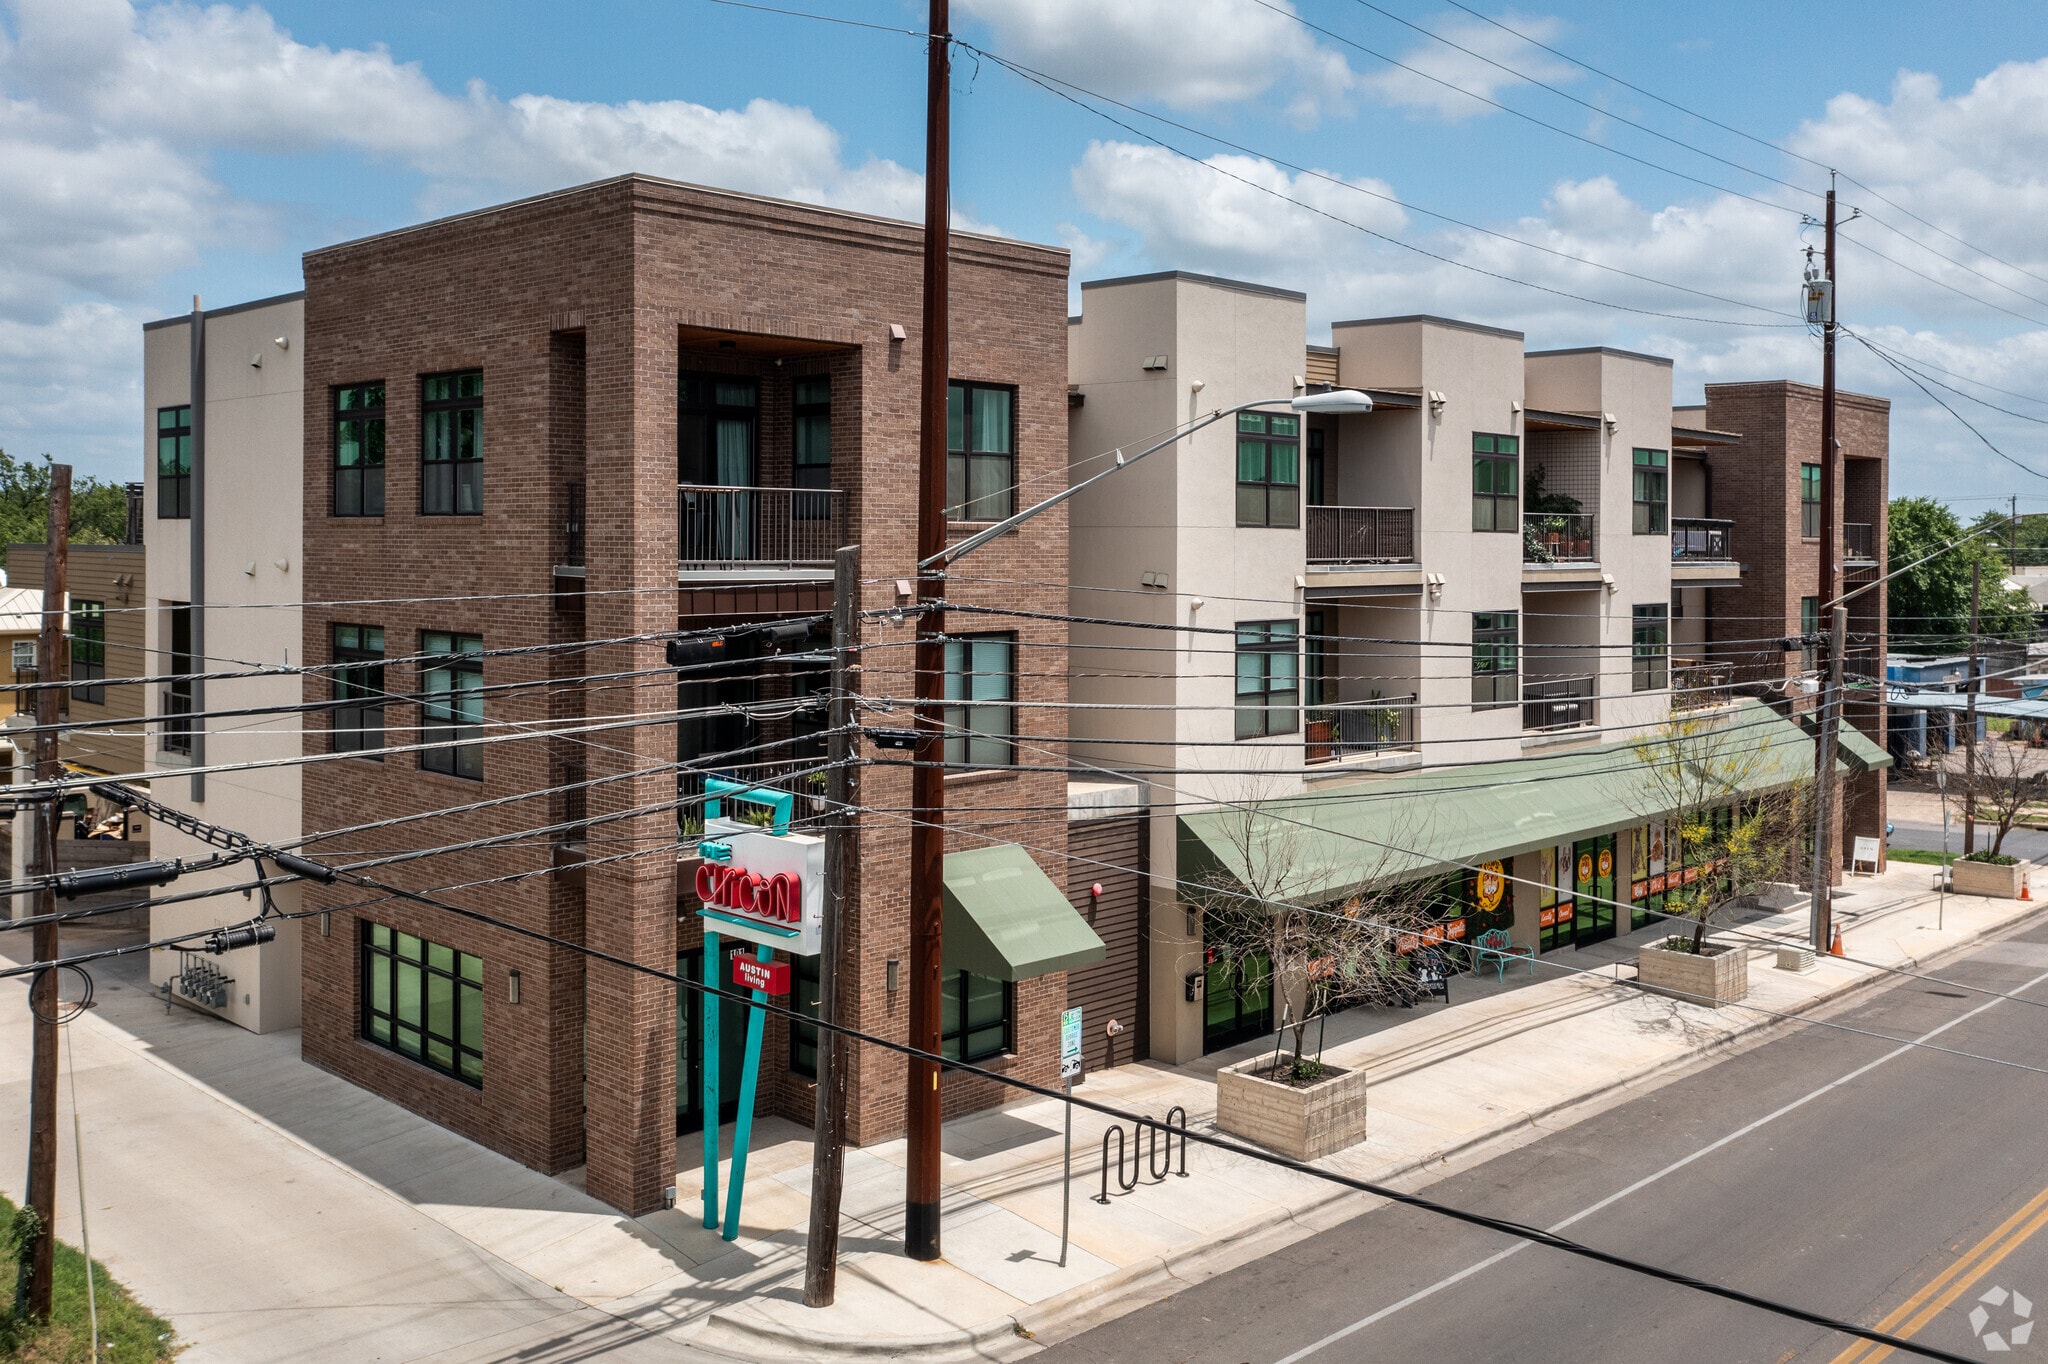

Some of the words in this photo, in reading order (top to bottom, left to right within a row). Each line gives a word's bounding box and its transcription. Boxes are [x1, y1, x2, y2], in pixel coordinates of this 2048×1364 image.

[697, 841, 731, 860] THE
[740, 962, 770, 979] AUSTIN
[744, 972, 765, 989] living
